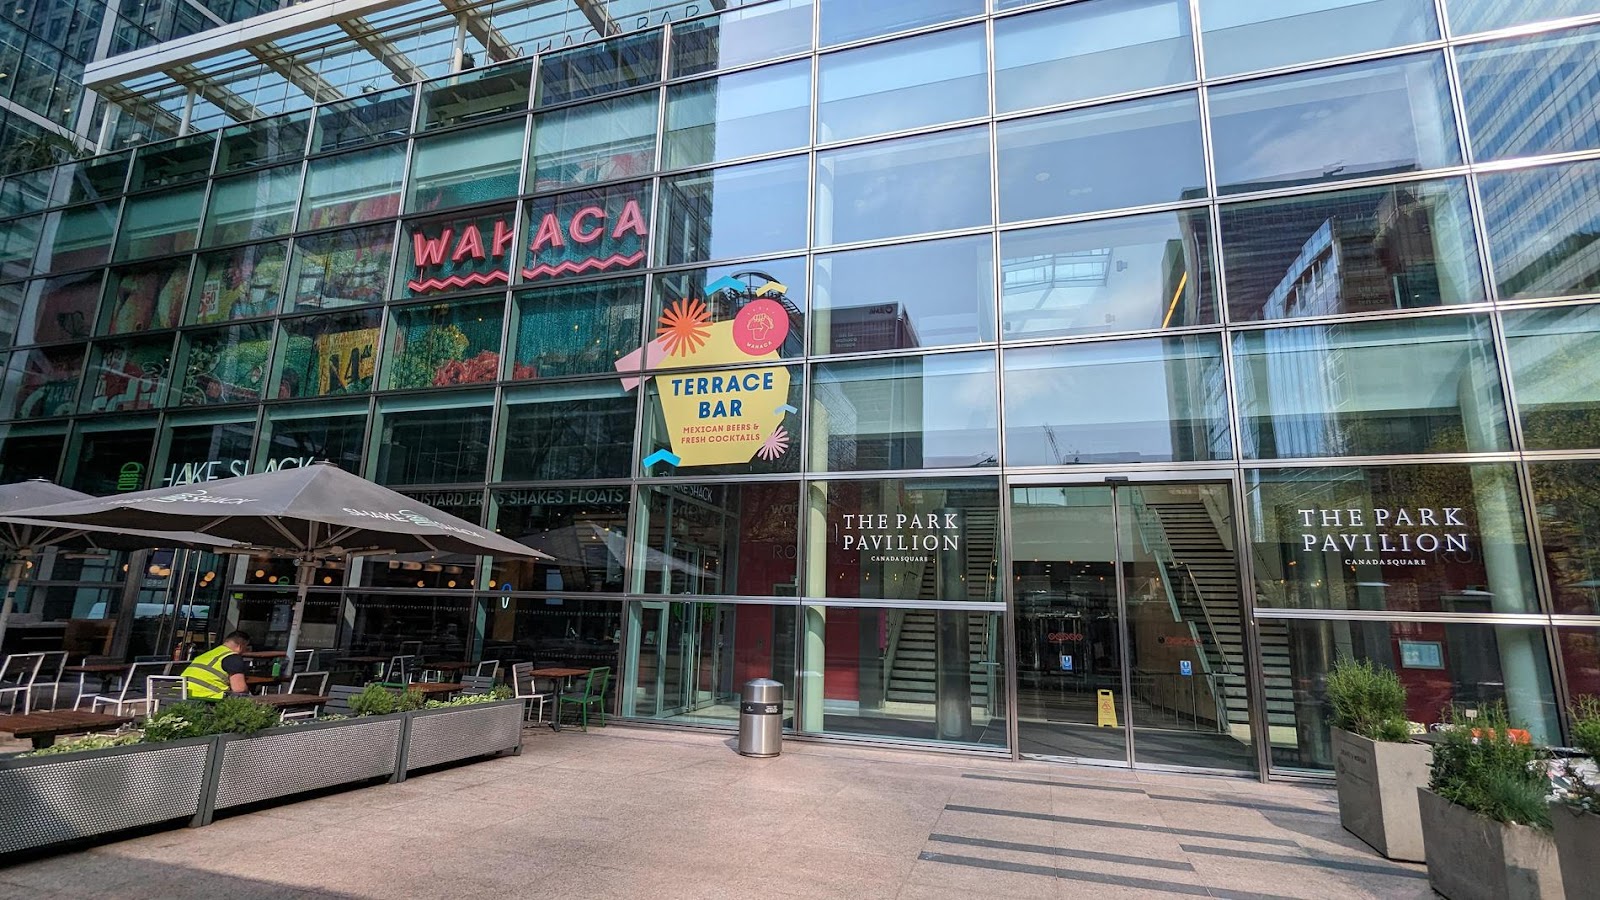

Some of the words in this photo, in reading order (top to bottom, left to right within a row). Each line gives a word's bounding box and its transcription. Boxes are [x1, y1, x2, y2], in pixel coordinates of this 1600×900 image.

[671, 372, 773, 396] TERRACE
[698, 399, 742, 419] BAR
[683, 424, 724, 433] MEXICAN
[726, 423, 751, 431] BEERS
[681, 436, 706, 444] FRESH
[708, 433, 760, 443] COCKTAILS
[509, 490, 564, 505] SHAKES
[569, 488, 624, 503] FLOATS
[843, 514, 888, 529] THE
[896, 513, 958, 529] PARK
[1298, 508, 1364, 527] THE
[1373, 507, 1465, 526] PARK
[843, 534, 960, 551] PAVILION
[1302, 533, 1468, 552] PAVILION
